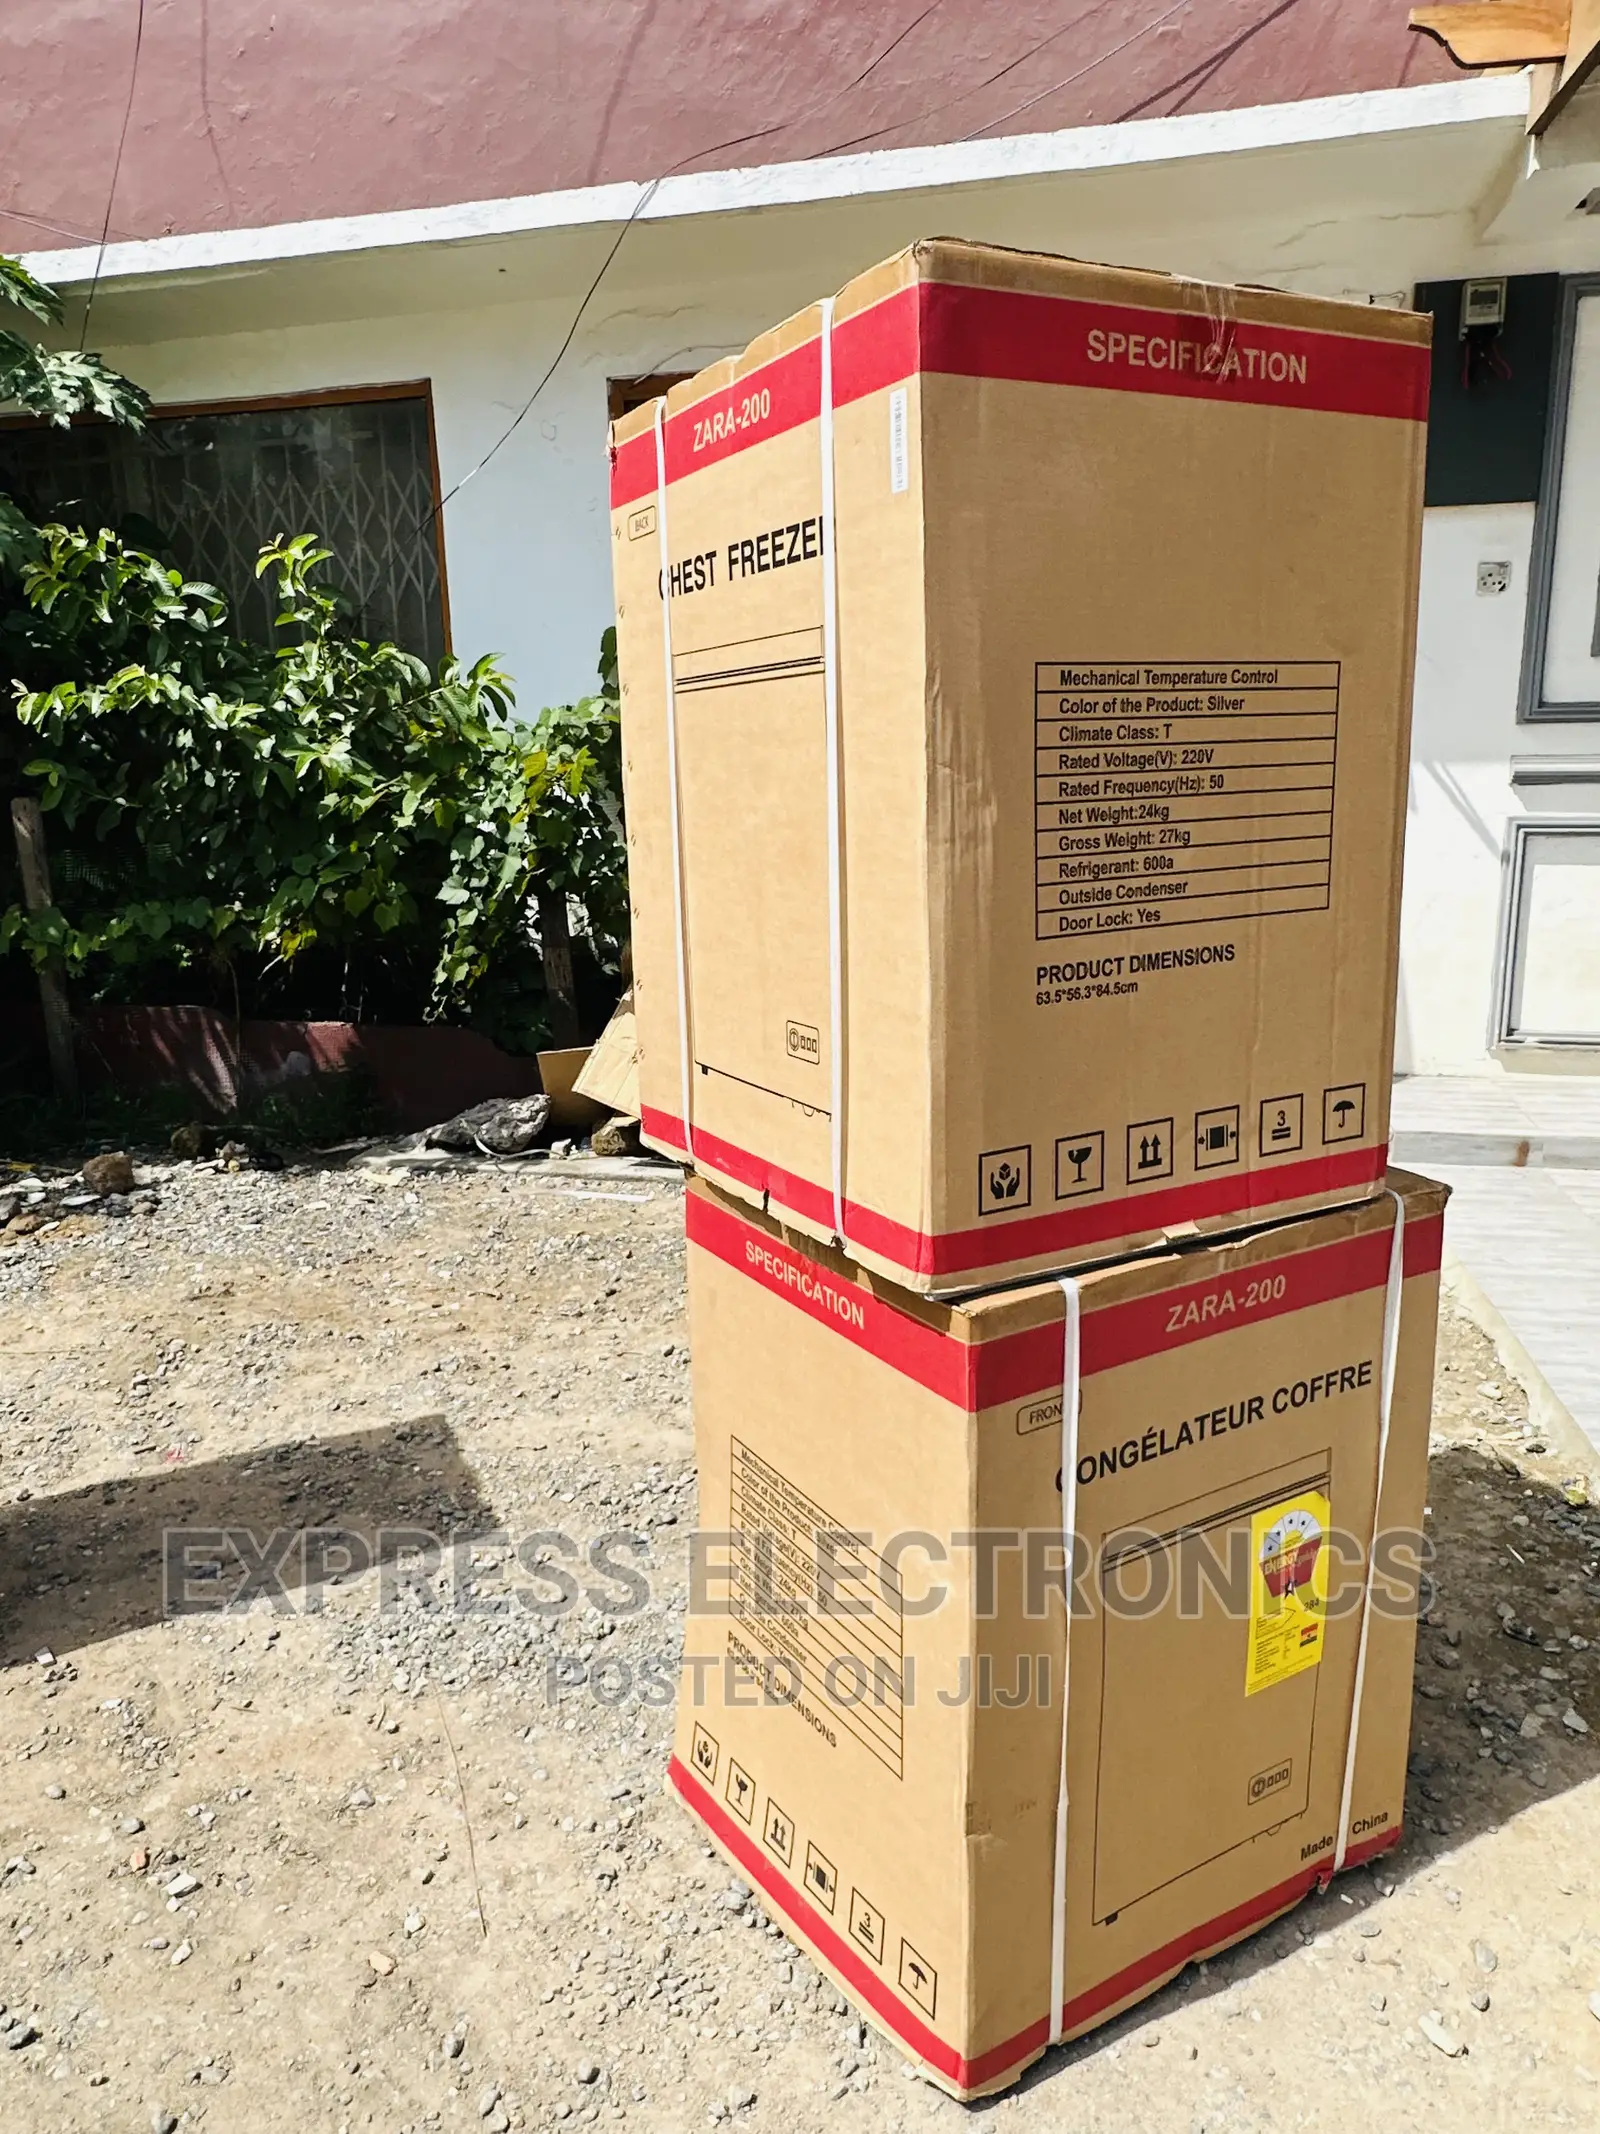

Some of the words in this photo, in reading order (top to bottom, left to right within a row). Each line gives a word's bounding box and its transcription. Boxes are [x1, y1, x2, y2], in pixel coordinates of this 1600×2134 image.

[1087, 329, 1308, 384] SPECIFICATION
[693, 387, 771, 452] ZARA-200
[1060, 669, 1140, 686] Mechanical
[1144, 669, 1227, 688] Temperature
[1231, 669, 1278, 684] Control
[1060, 698, 1099, 714] Color
[1102, 697, 1118, 713] of
[1120, 697, 1142, 713] the
[1146, 697, 1203, 712] Product:
[1207, 695, 1245, 711] Silver
[1059, 726, 1113, 741] Climate
[1117, 724, 1159, 740] Class:
[1163, 723, 1172, 739] T
[1059, 753, 1100, 770] Rated
[1103, 750, 1178, 770] Voltage(V):
[1181, 749, 1214, 765] 220V
[1059, 781, 1100, 797] Rated
[1103, 776, 1205, 797] Frequency(Hz):
[1209, 774, 1225, 789] 50
[1059, 809, 1083, 824] Net
[1059, 836, 1101, 851] Gross
[1104, 832, 1156, 850] Weight:
[1159, 829, 1191, 845] 27kg
[1059, 858, 1140, 880] Refrigerant:
[1143, 856, 1174, 871] 600a
[1059, 887, 1112, 905] Outside
[1116, 881, 1189, 899] Condenser
[1059, 916, 1093, 932] Door
[1096, 910, 1134, 928] Lock:
[1137, 909, 1161, 923] Yes
[1036, 957, 1125, 986] PRODUCT
[1129, 944, 1235, 974] DIMENSIONS
[1277, 1110, 1286, 1126] 3
[745, 1240, 865, 1330] SPECIFICATION
[1165, 1274, 1286, 1333] ZARA-200
[1272, 1361, 1373, 1414] COFFRE
[1029, 1400, 1063, 1425] FRON
[728, 1630, 771, 1683] PRODUCT
[774, 1677, 837, 1748] DIMENSIONS
[1301, 1835, 1333, 1861] Made
[1352, 1812, 1388, 1834] China
[863, 1912, 871, 1928] 3
